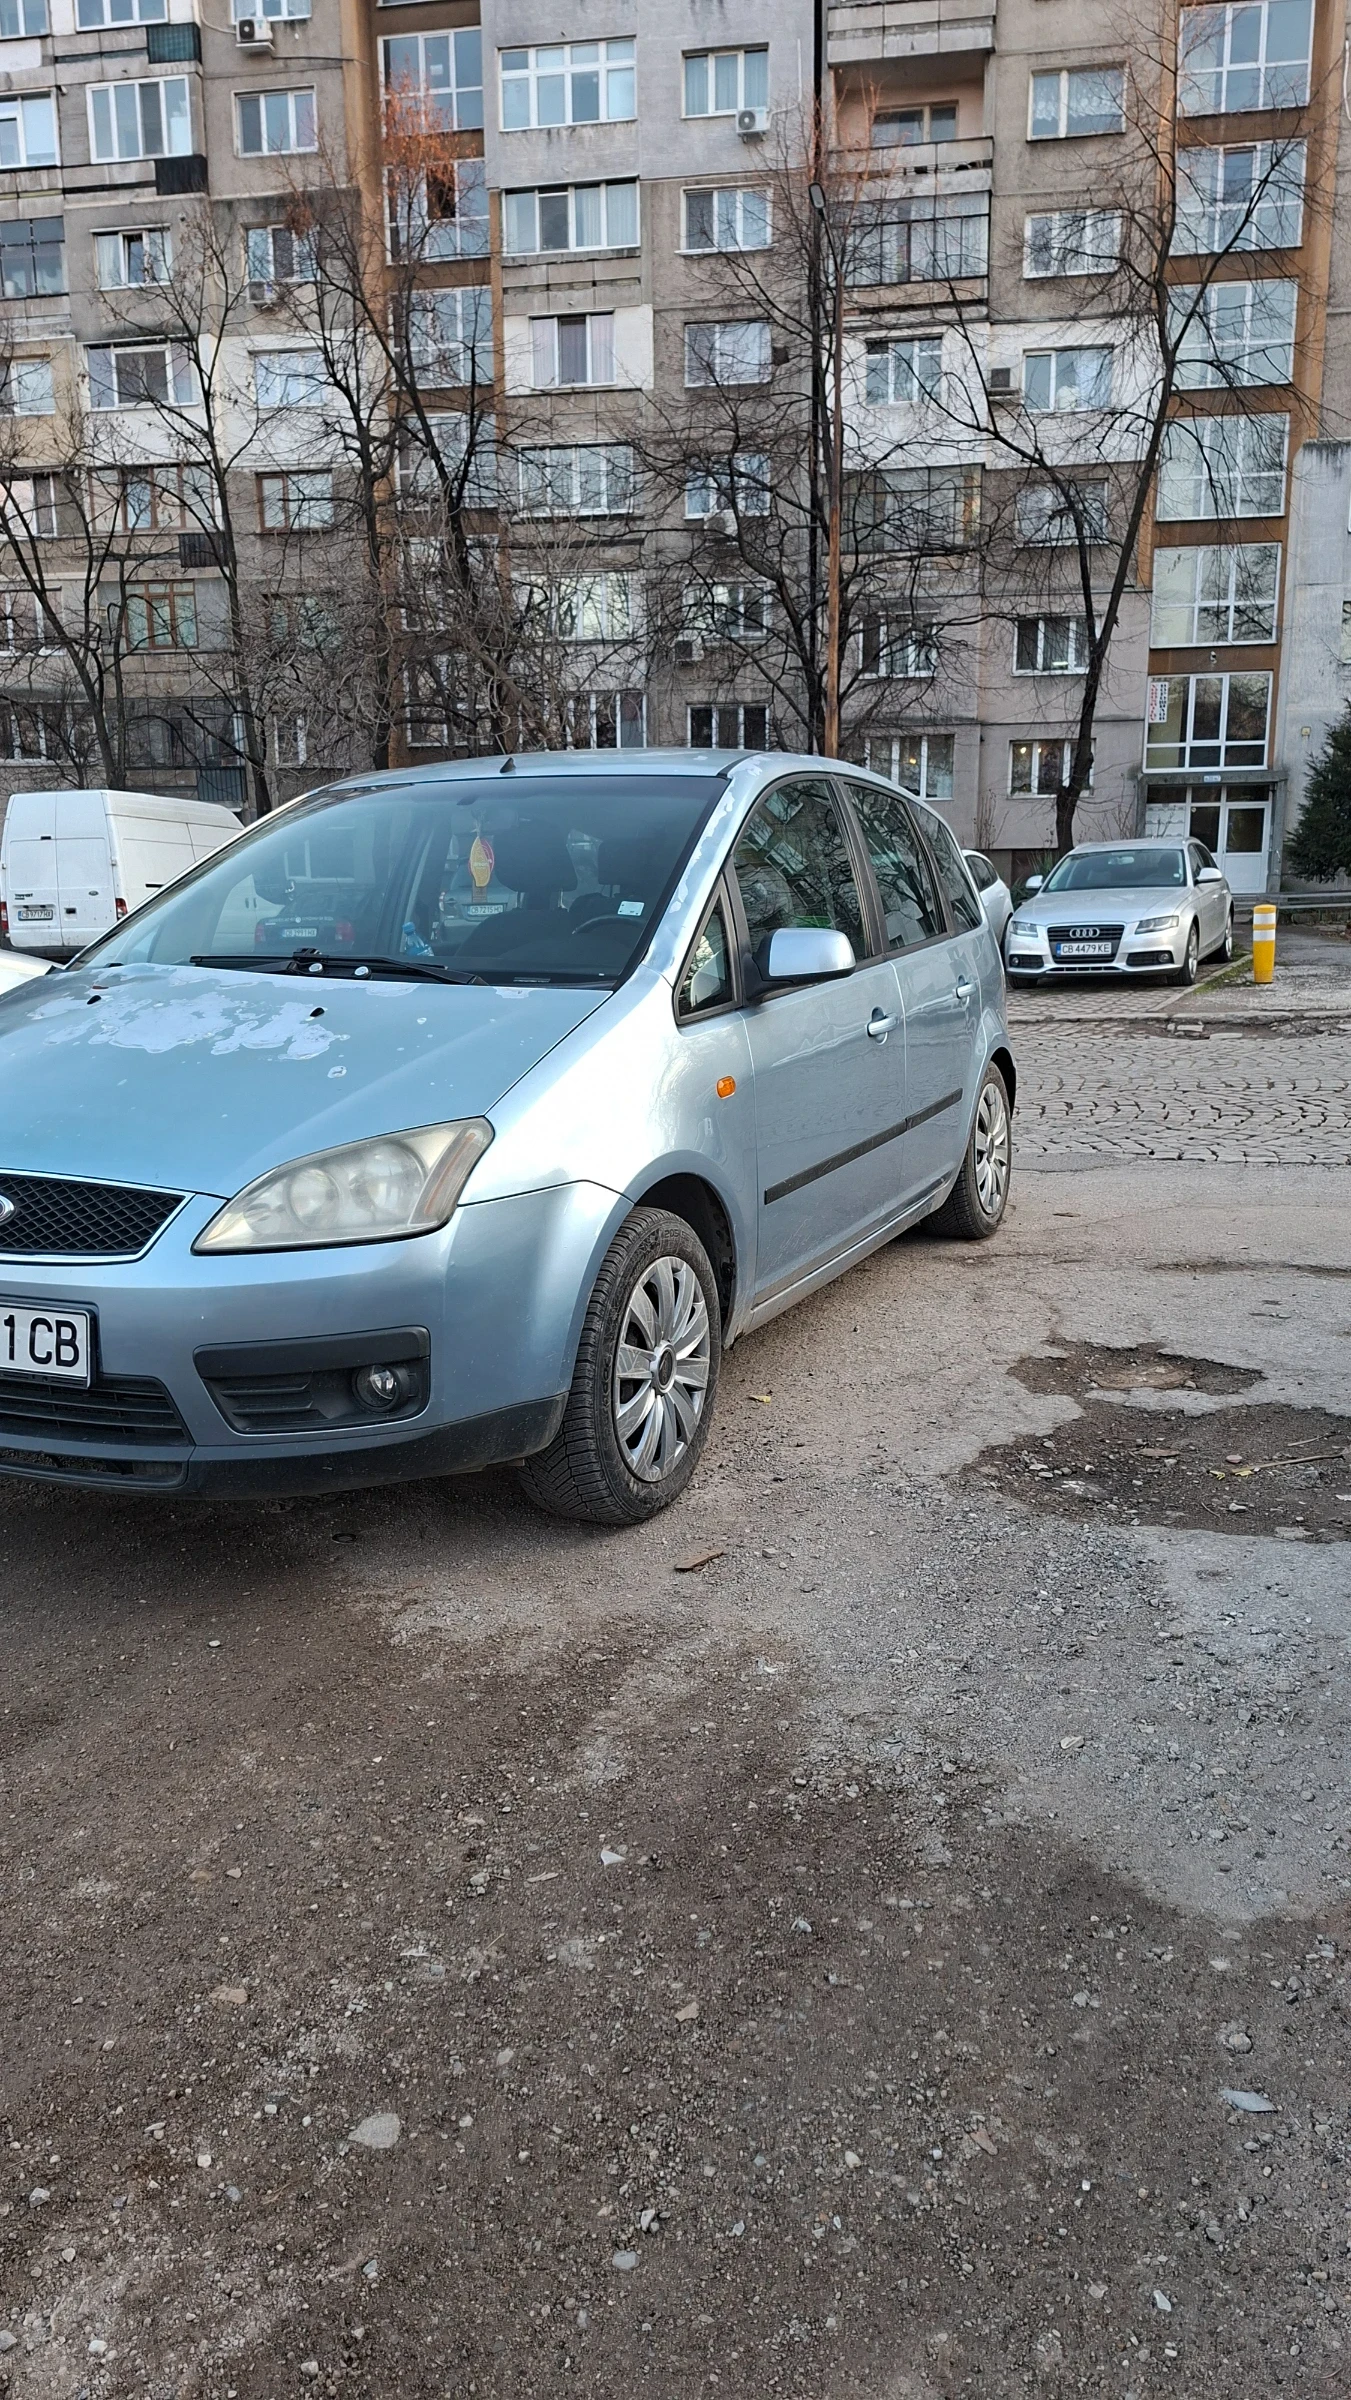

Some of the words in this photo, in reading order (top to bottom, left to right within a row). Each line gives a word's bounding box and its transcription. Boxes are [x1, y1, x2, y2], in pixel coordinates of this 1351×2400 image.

[1062, 944, 1073, 954] CB
[1075, 944, 1097, 954] 4479
[1097, 943, 1110, 953] KE
[29, 1317, 80, 1367] CB
